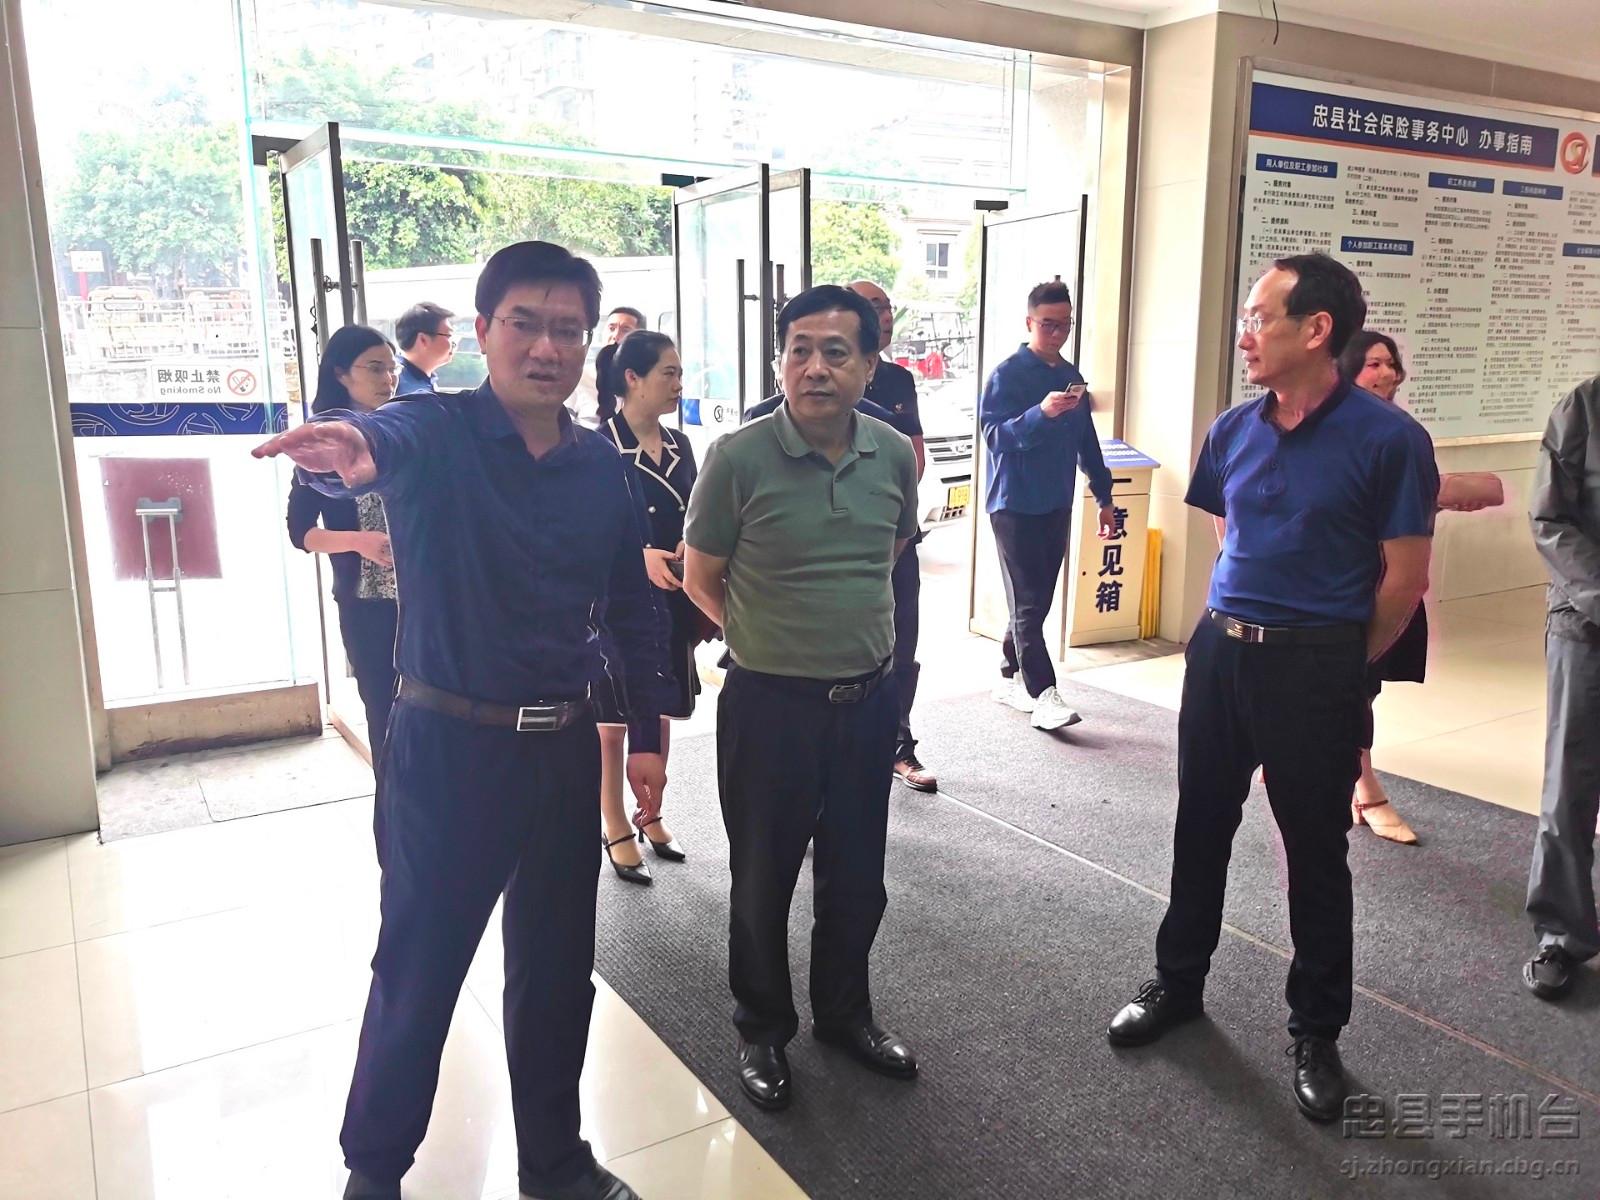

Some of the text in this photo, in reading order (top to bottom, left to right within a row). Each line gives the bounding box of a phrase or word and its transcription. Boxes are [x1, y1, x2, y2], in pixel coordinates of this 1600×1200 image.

[1312, 104, 1534, 156] 忠县社会保险事务中心 办事指南
